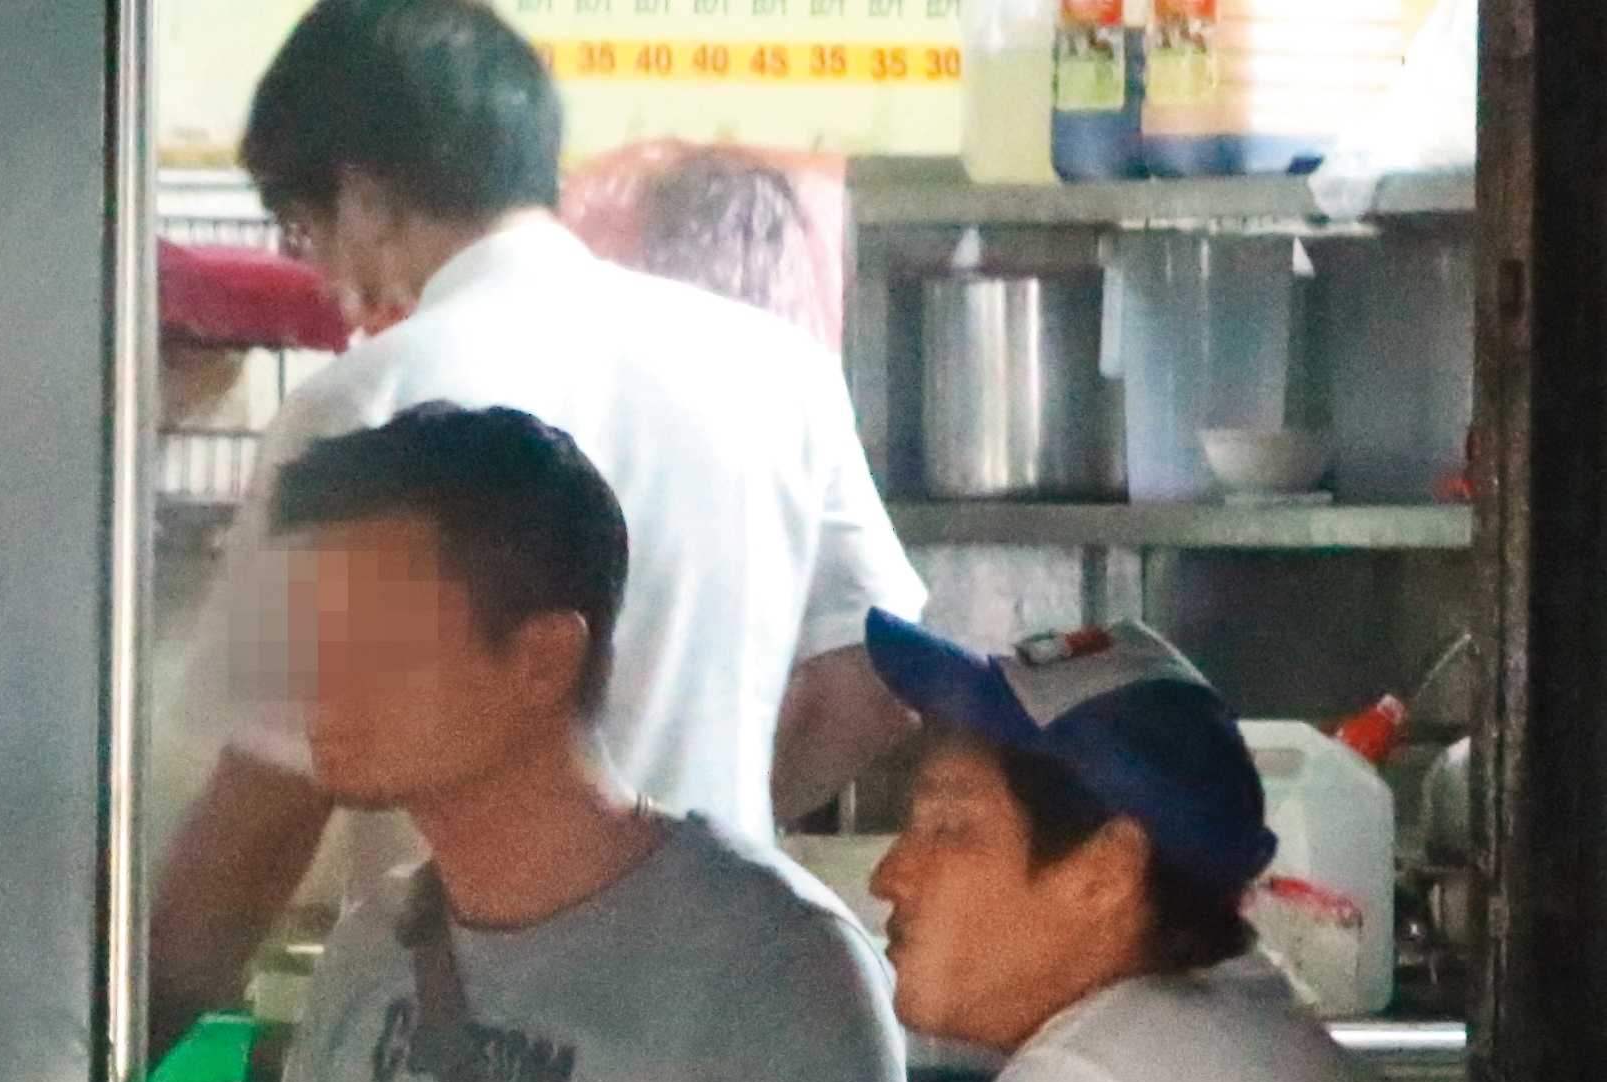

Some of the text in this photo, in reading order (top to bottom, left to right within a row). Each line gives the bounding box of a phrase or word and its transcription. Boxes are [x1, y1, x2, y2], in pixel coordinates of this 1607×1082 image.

[579, 41, 616, 74] 35
[635, 44, 672, 76] 40
[694, 44, 729, 76] 40
[750, 44, 789, 77] 45
[811, 44, 847, 76] 35
[871, 47, 907, 80] 35
[926, 48, 960, 79] 30
